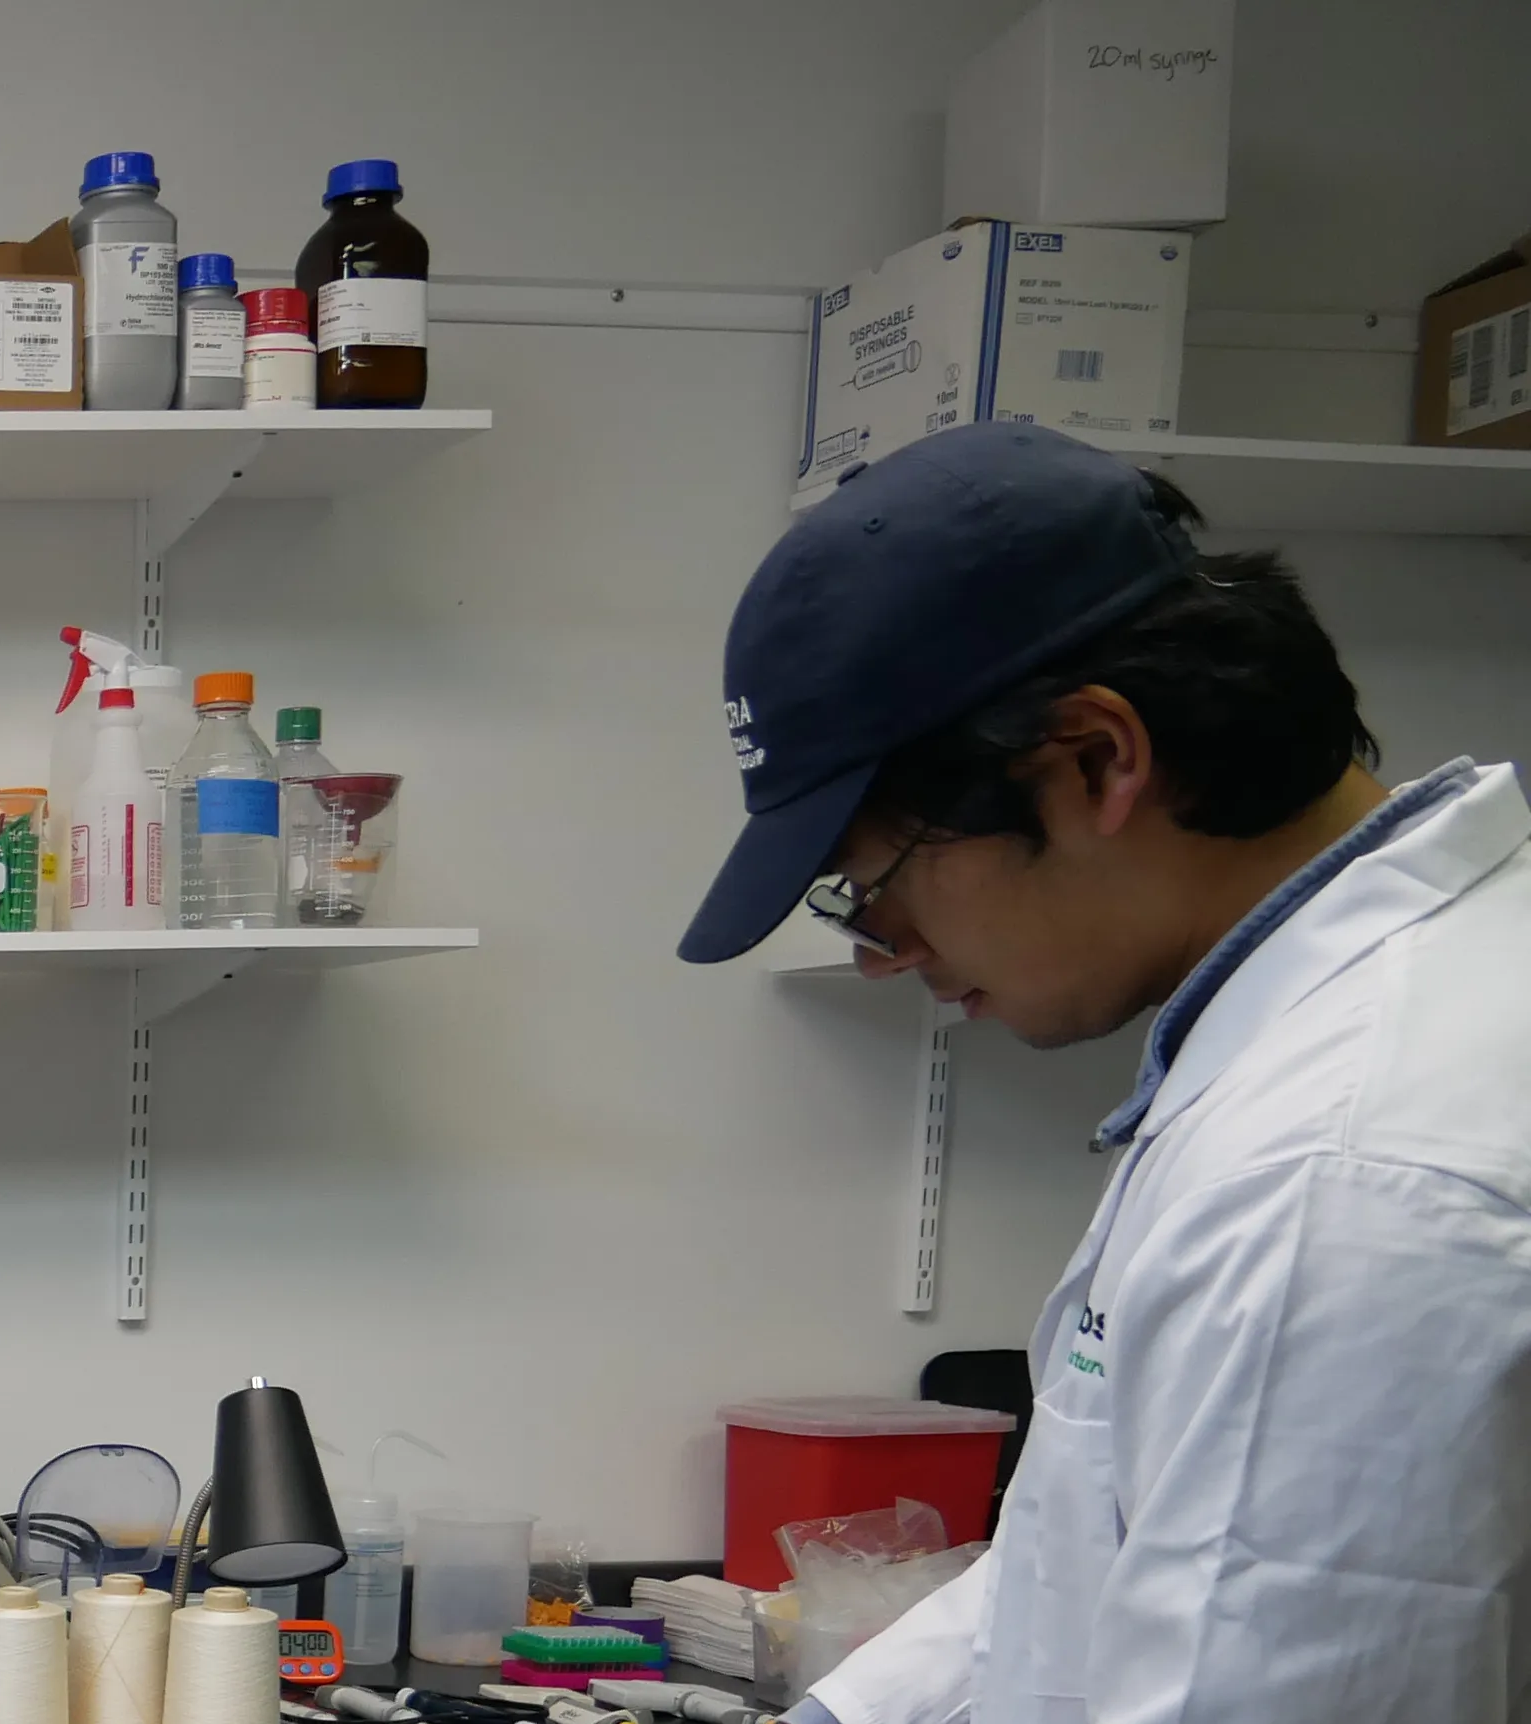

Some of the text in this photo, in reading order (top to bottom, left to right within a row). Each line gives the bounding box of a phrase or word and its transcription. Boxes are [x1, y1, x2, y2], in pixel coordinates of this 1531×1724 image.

[1087, 45, 1218, 81] 20ml syringe
[1016, 233, 1062, 251] EXEL
[849, 305, 916, 346] DISPOSABLE
[855, 327, 908, 361] SYRINGES
[936, 386, 959, 406] 10ml
[939, 409, 958, 428] 100
